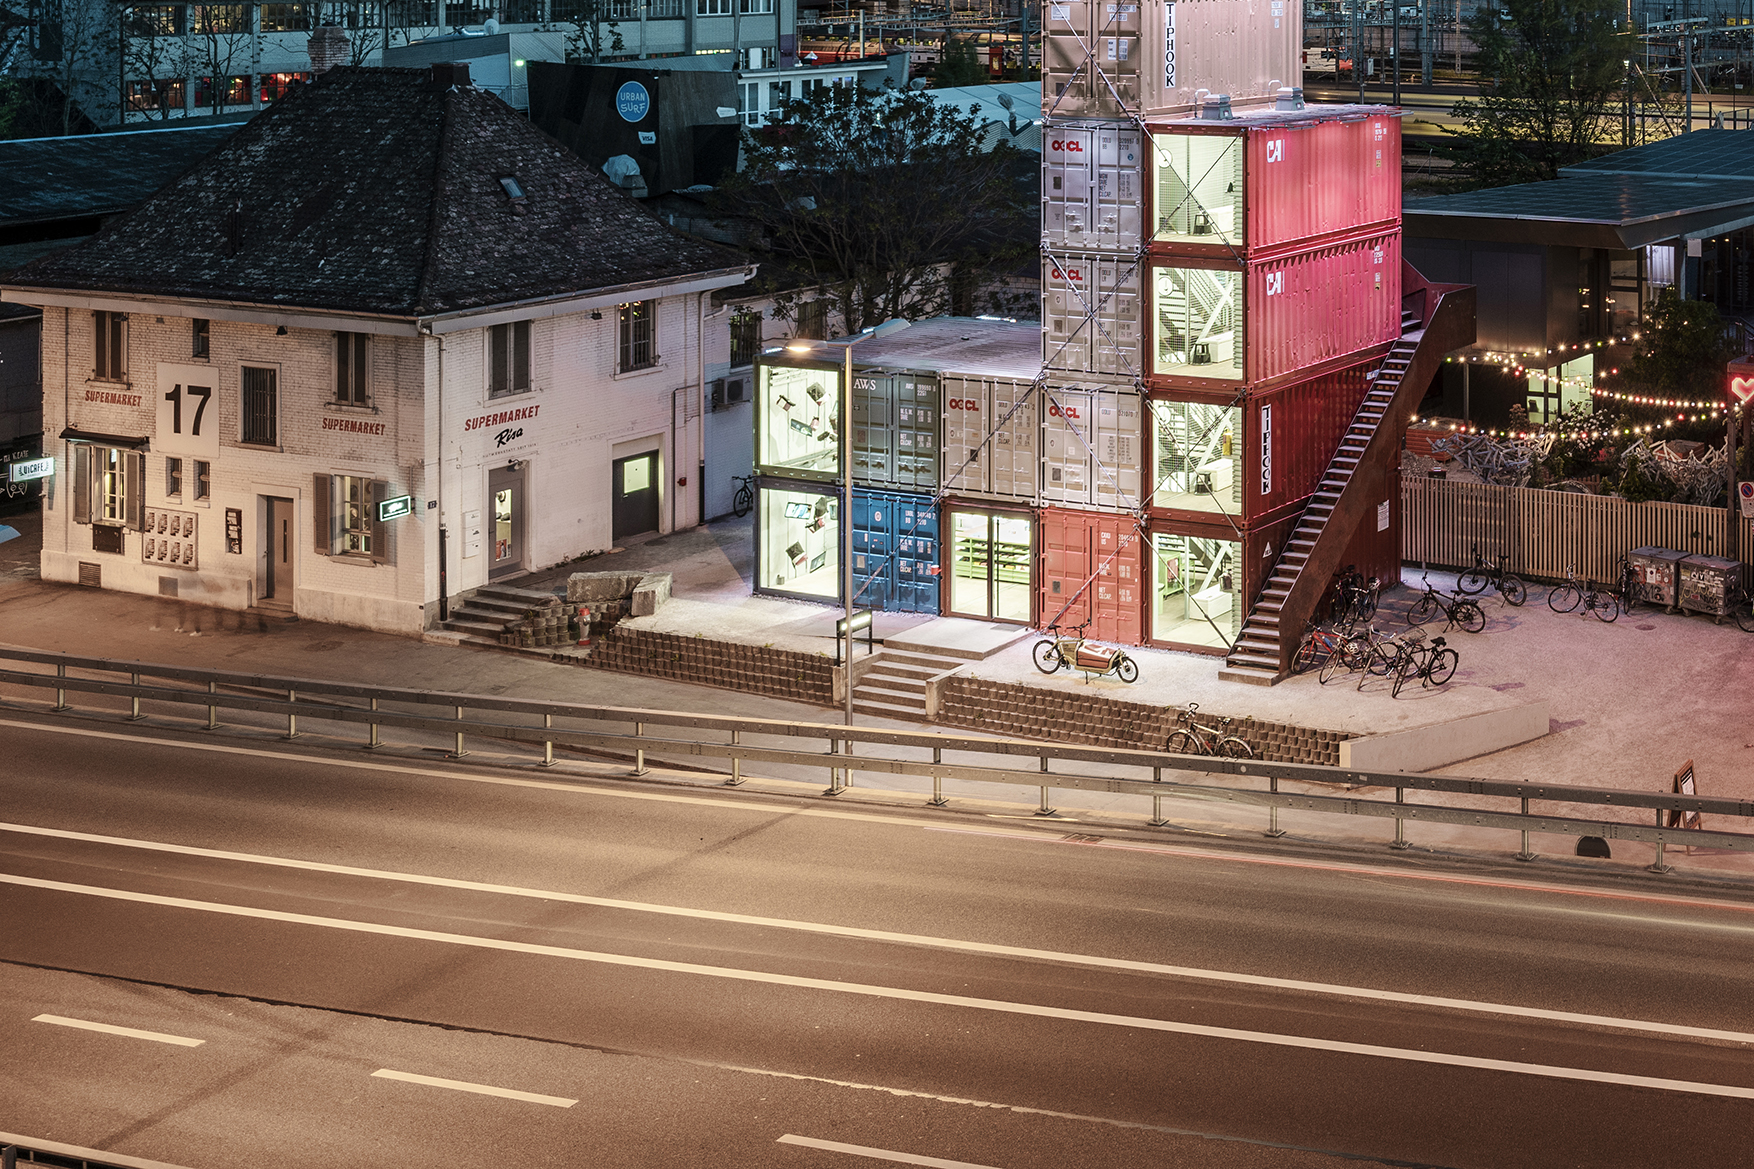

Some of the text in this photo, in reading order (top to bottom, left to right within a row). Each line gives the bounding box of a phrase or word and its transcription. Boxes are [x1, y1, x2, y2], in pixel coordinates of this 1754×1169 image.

[1166, 3, 1175, 88] TIPHOOK
[620, 92, 645, 102] URBAN
[621, 102, 646, 114] SURF
[853, 378, 876, 391] AWS
[85, 390, 142, 407] SUPERMARKET
[165, 383, 212, 437] 17
[465, 405, 541, 432] SUPERMARKET
[322, 417, 386, 436] SUPERMARKET
[494, 427, 524, 449] Risa
